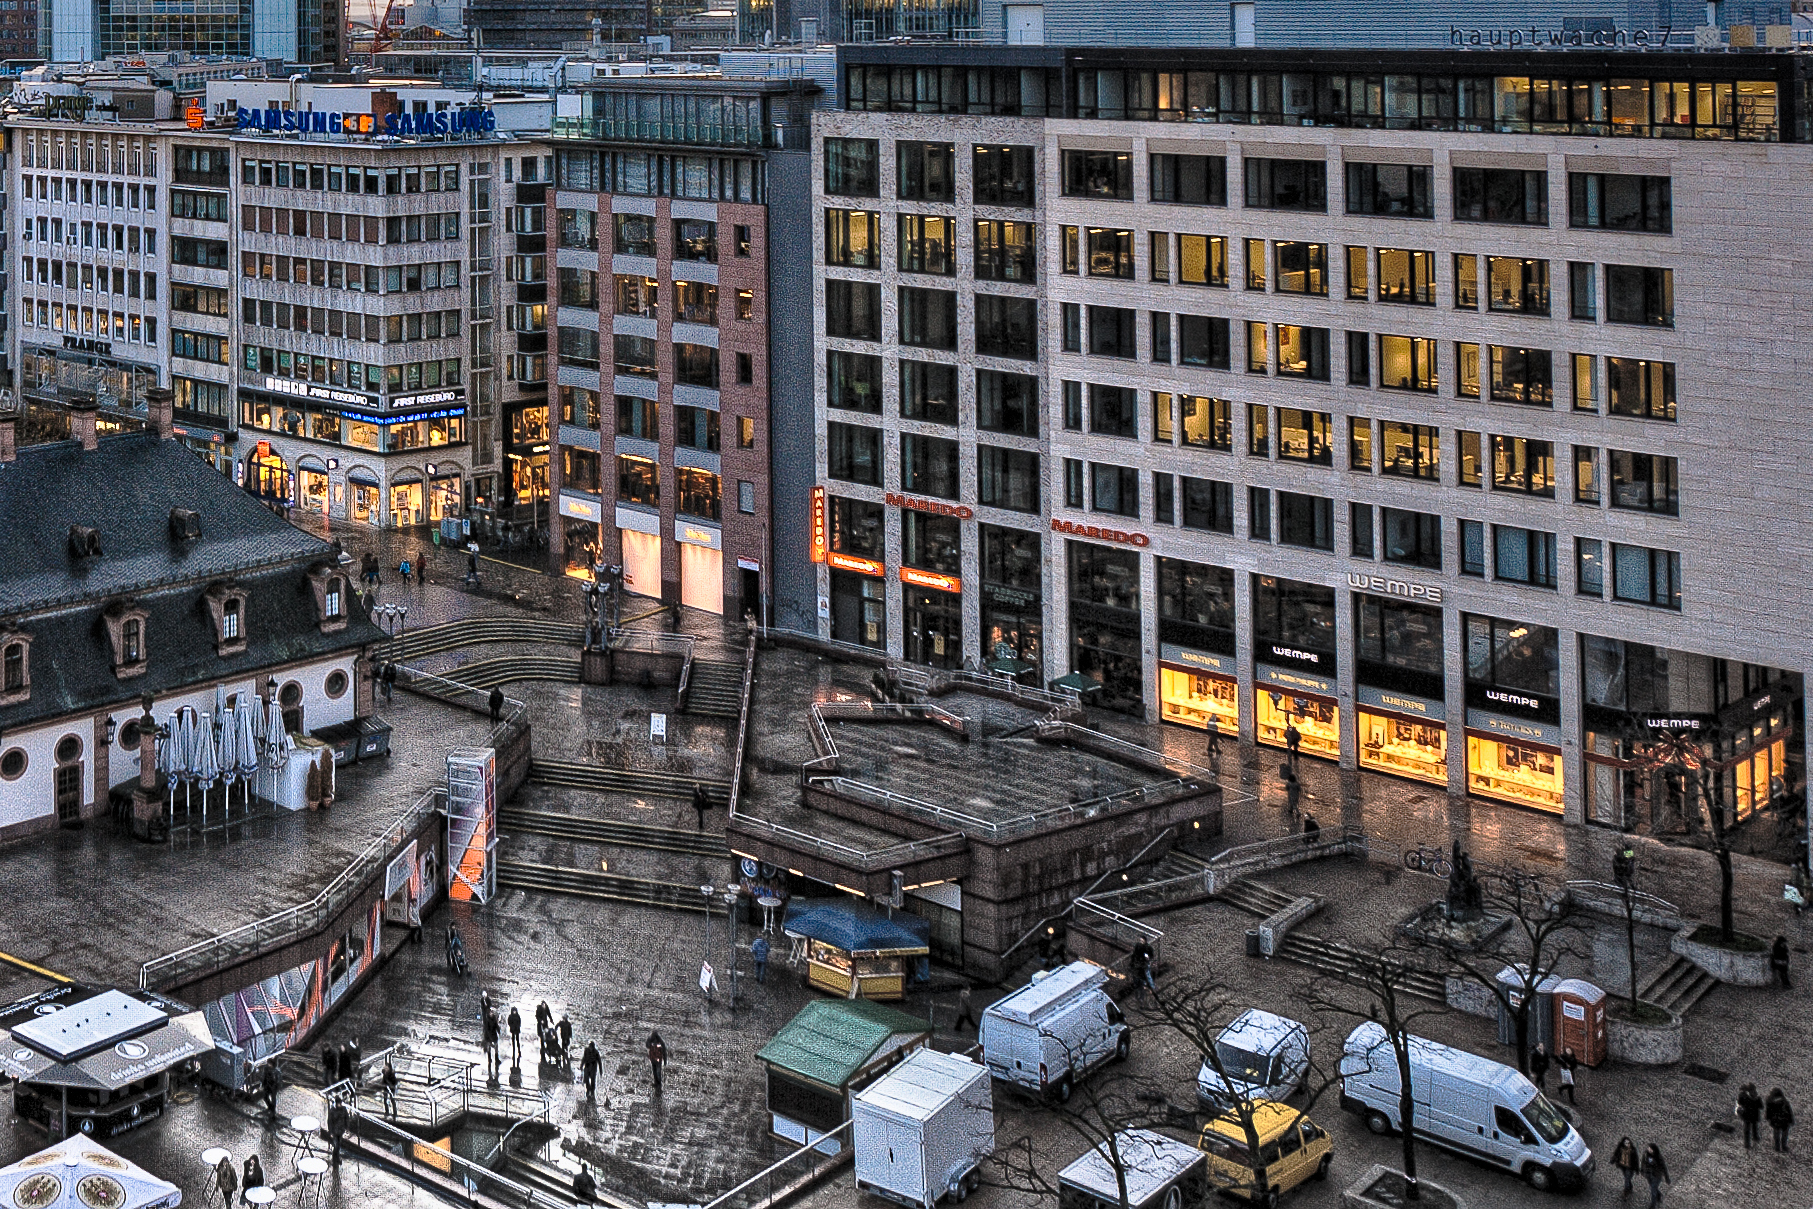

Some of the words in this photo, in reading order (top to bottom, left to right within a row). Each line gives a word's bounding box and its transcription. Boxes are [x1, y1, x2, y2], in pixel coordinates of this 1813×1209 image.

[237, 106, 342, 134] SAMSUNG
[384, 108, 495, 136] SAMSUNG
[814, 489, 824, 546] MAREDO
[885, 492, 973, 520] MAREDO
[1051, 518, 1150, 547] MAREDO
[1347, 571, 1443, 602] WEMPE
[1272, 645, 1319, 663] WEMPE
[1381, 693, 1427, 712] WEMPE
[1486, 690, 1539, 709] WEMPE
[1647, 718, 1700, 729] WEMPE
[144, 1041, 195, 1068] unlimited
